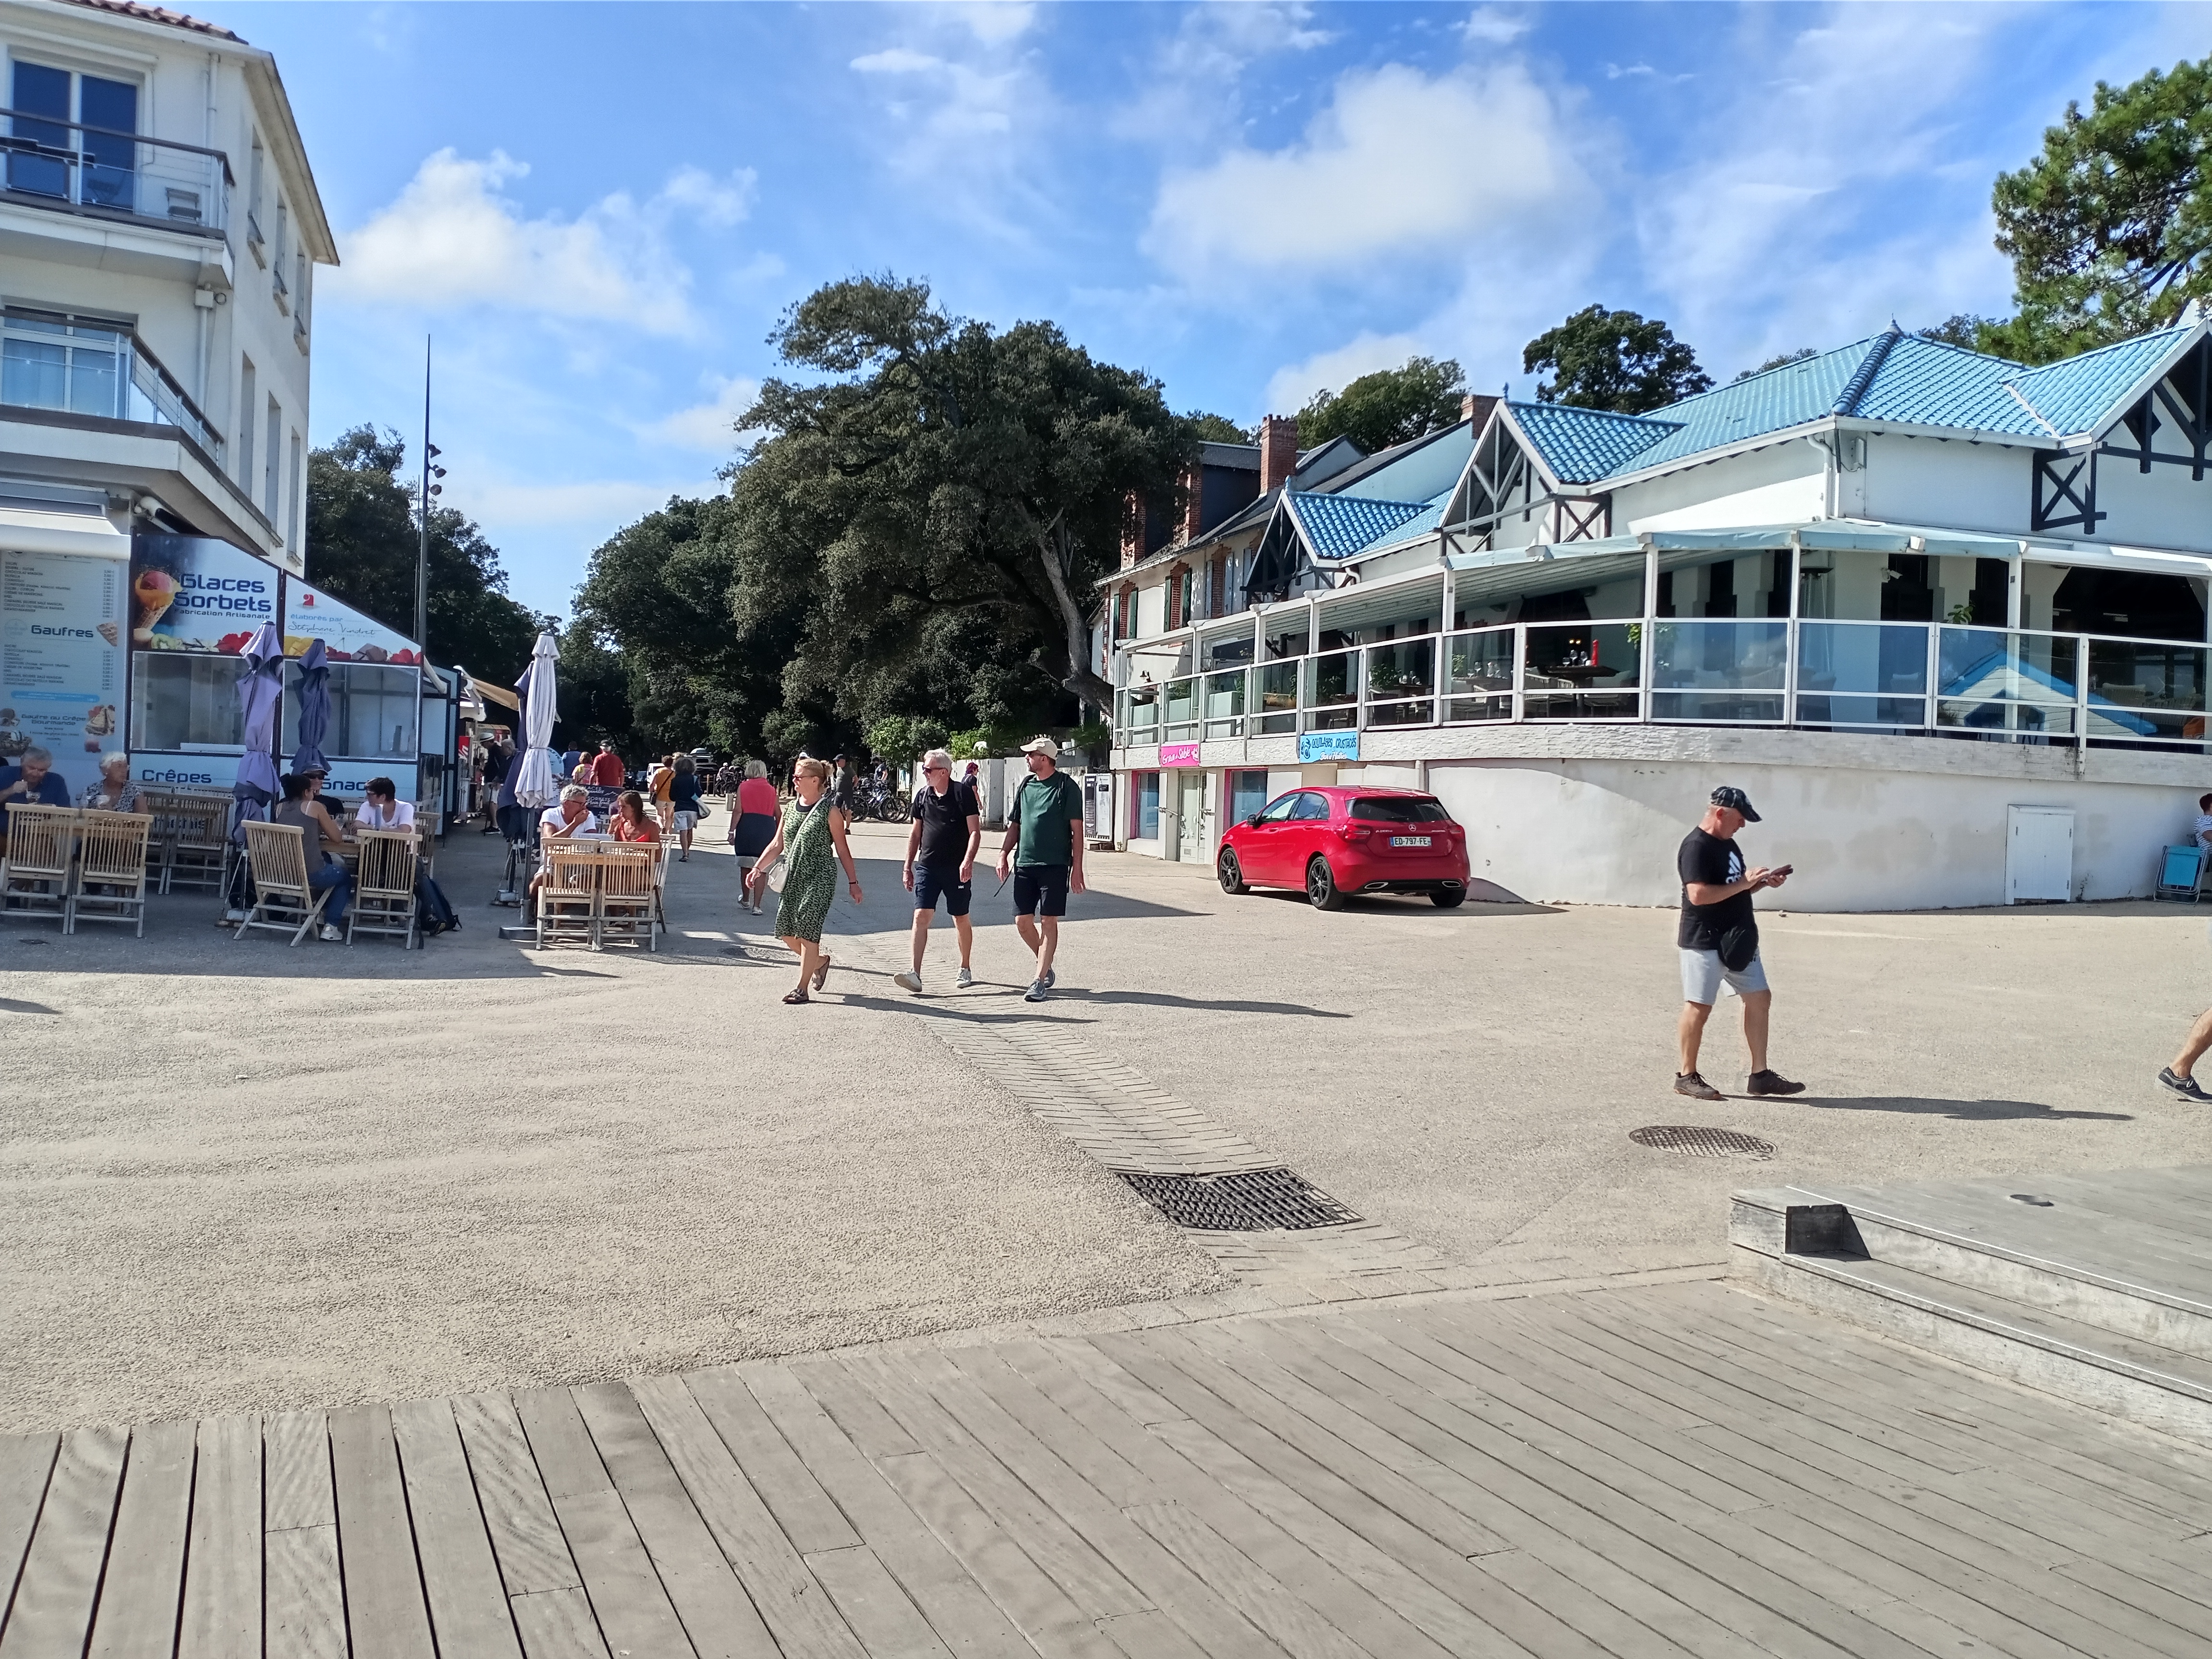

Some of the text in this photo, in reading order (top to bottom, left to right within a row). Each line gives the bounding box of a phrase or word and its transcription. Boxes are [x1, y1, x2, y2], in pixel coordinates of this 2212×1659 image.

[180, 574, 265, 593] Glaces
[174, 591, 271, 612] Sorbets
[31, 625, 94, 638] Gaufres
[288, 621, 336, 633] Stéphane
[142, 769, 212, 783] Crêpes
[321, 778, 369, 791] Snac
